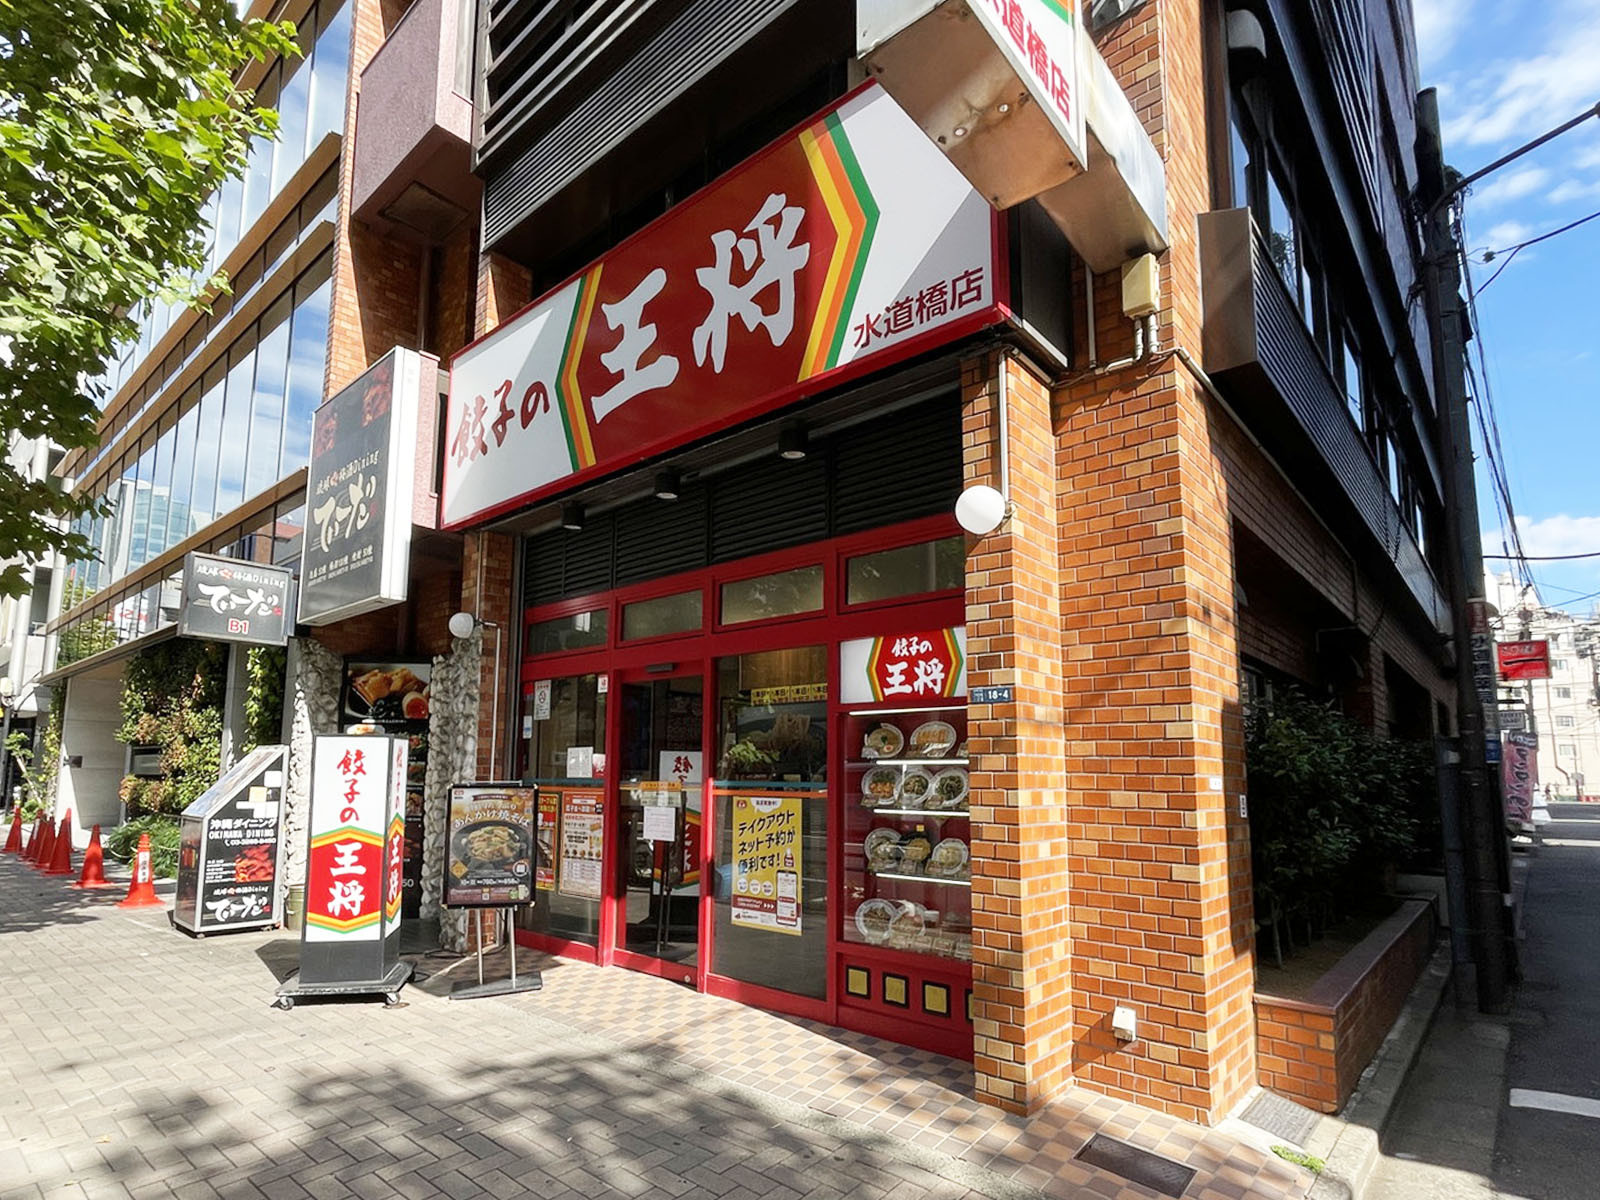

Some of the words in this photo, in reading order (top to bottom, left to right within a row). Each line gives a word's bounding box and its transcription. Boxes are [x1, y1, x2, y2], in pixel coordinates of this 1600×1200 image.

[853, 267, 984, 348] 水道橋店
[452, 379, 550, 467] 餃子の
[591, 193, 811, 424] 王将
[313, 473, 377, 552] てぃーだ
[198, 583, 280, 616] てぃーだ
[228, 618, 250, 634] B1
[891, 636, 933, 657] 餃子の
[883, 657, 945, 696] 王将
[988, 689, 1009, 700] 18-4
[337, 749, 367, 823] 餃子の
[208, 830, 243, 840] OKINAWA
[246, 828, 275, 838] DINING
[210, 818, 278, 830] 沖縄ダイニング
[738, 809, 796, 837] テイクアウト
[738, 826, 796, 855] ネット予約が
[328, 842, 367, 917] 王将
[205, 894, 268, 922] てぃーだ
